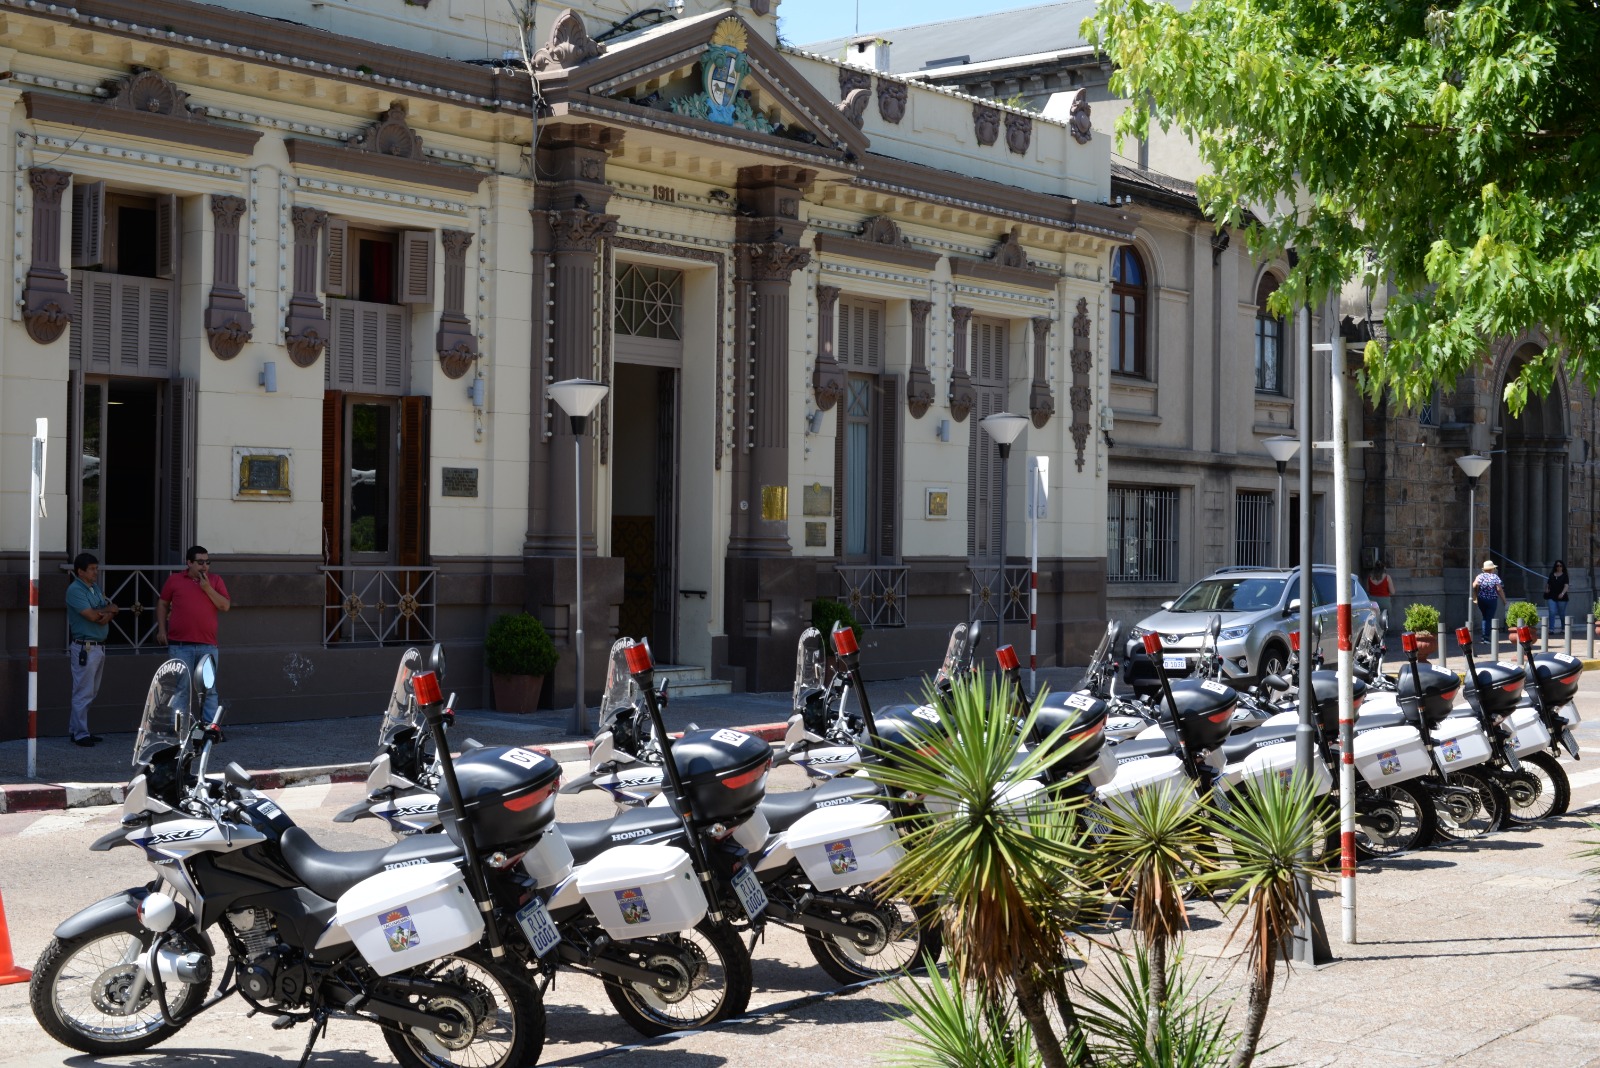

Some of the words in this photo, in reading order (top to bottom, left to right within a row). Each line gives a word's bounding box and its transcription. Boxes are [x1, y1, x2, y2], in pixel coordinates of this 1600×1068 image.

[653, 184, 675, 203] 1911
[1256, 737, 1286, 748] HONDA
[816, 796, 854, 809] HONDA
[611, 828, 654, 841] HONDA
[384, 857, 430, 871] HONDA
[740, 877, 756, 898] RID
[746, 889, 766, 914] 0002
[527, 910, 547, 934] RID
[533, 924, 558, 951] 0001
